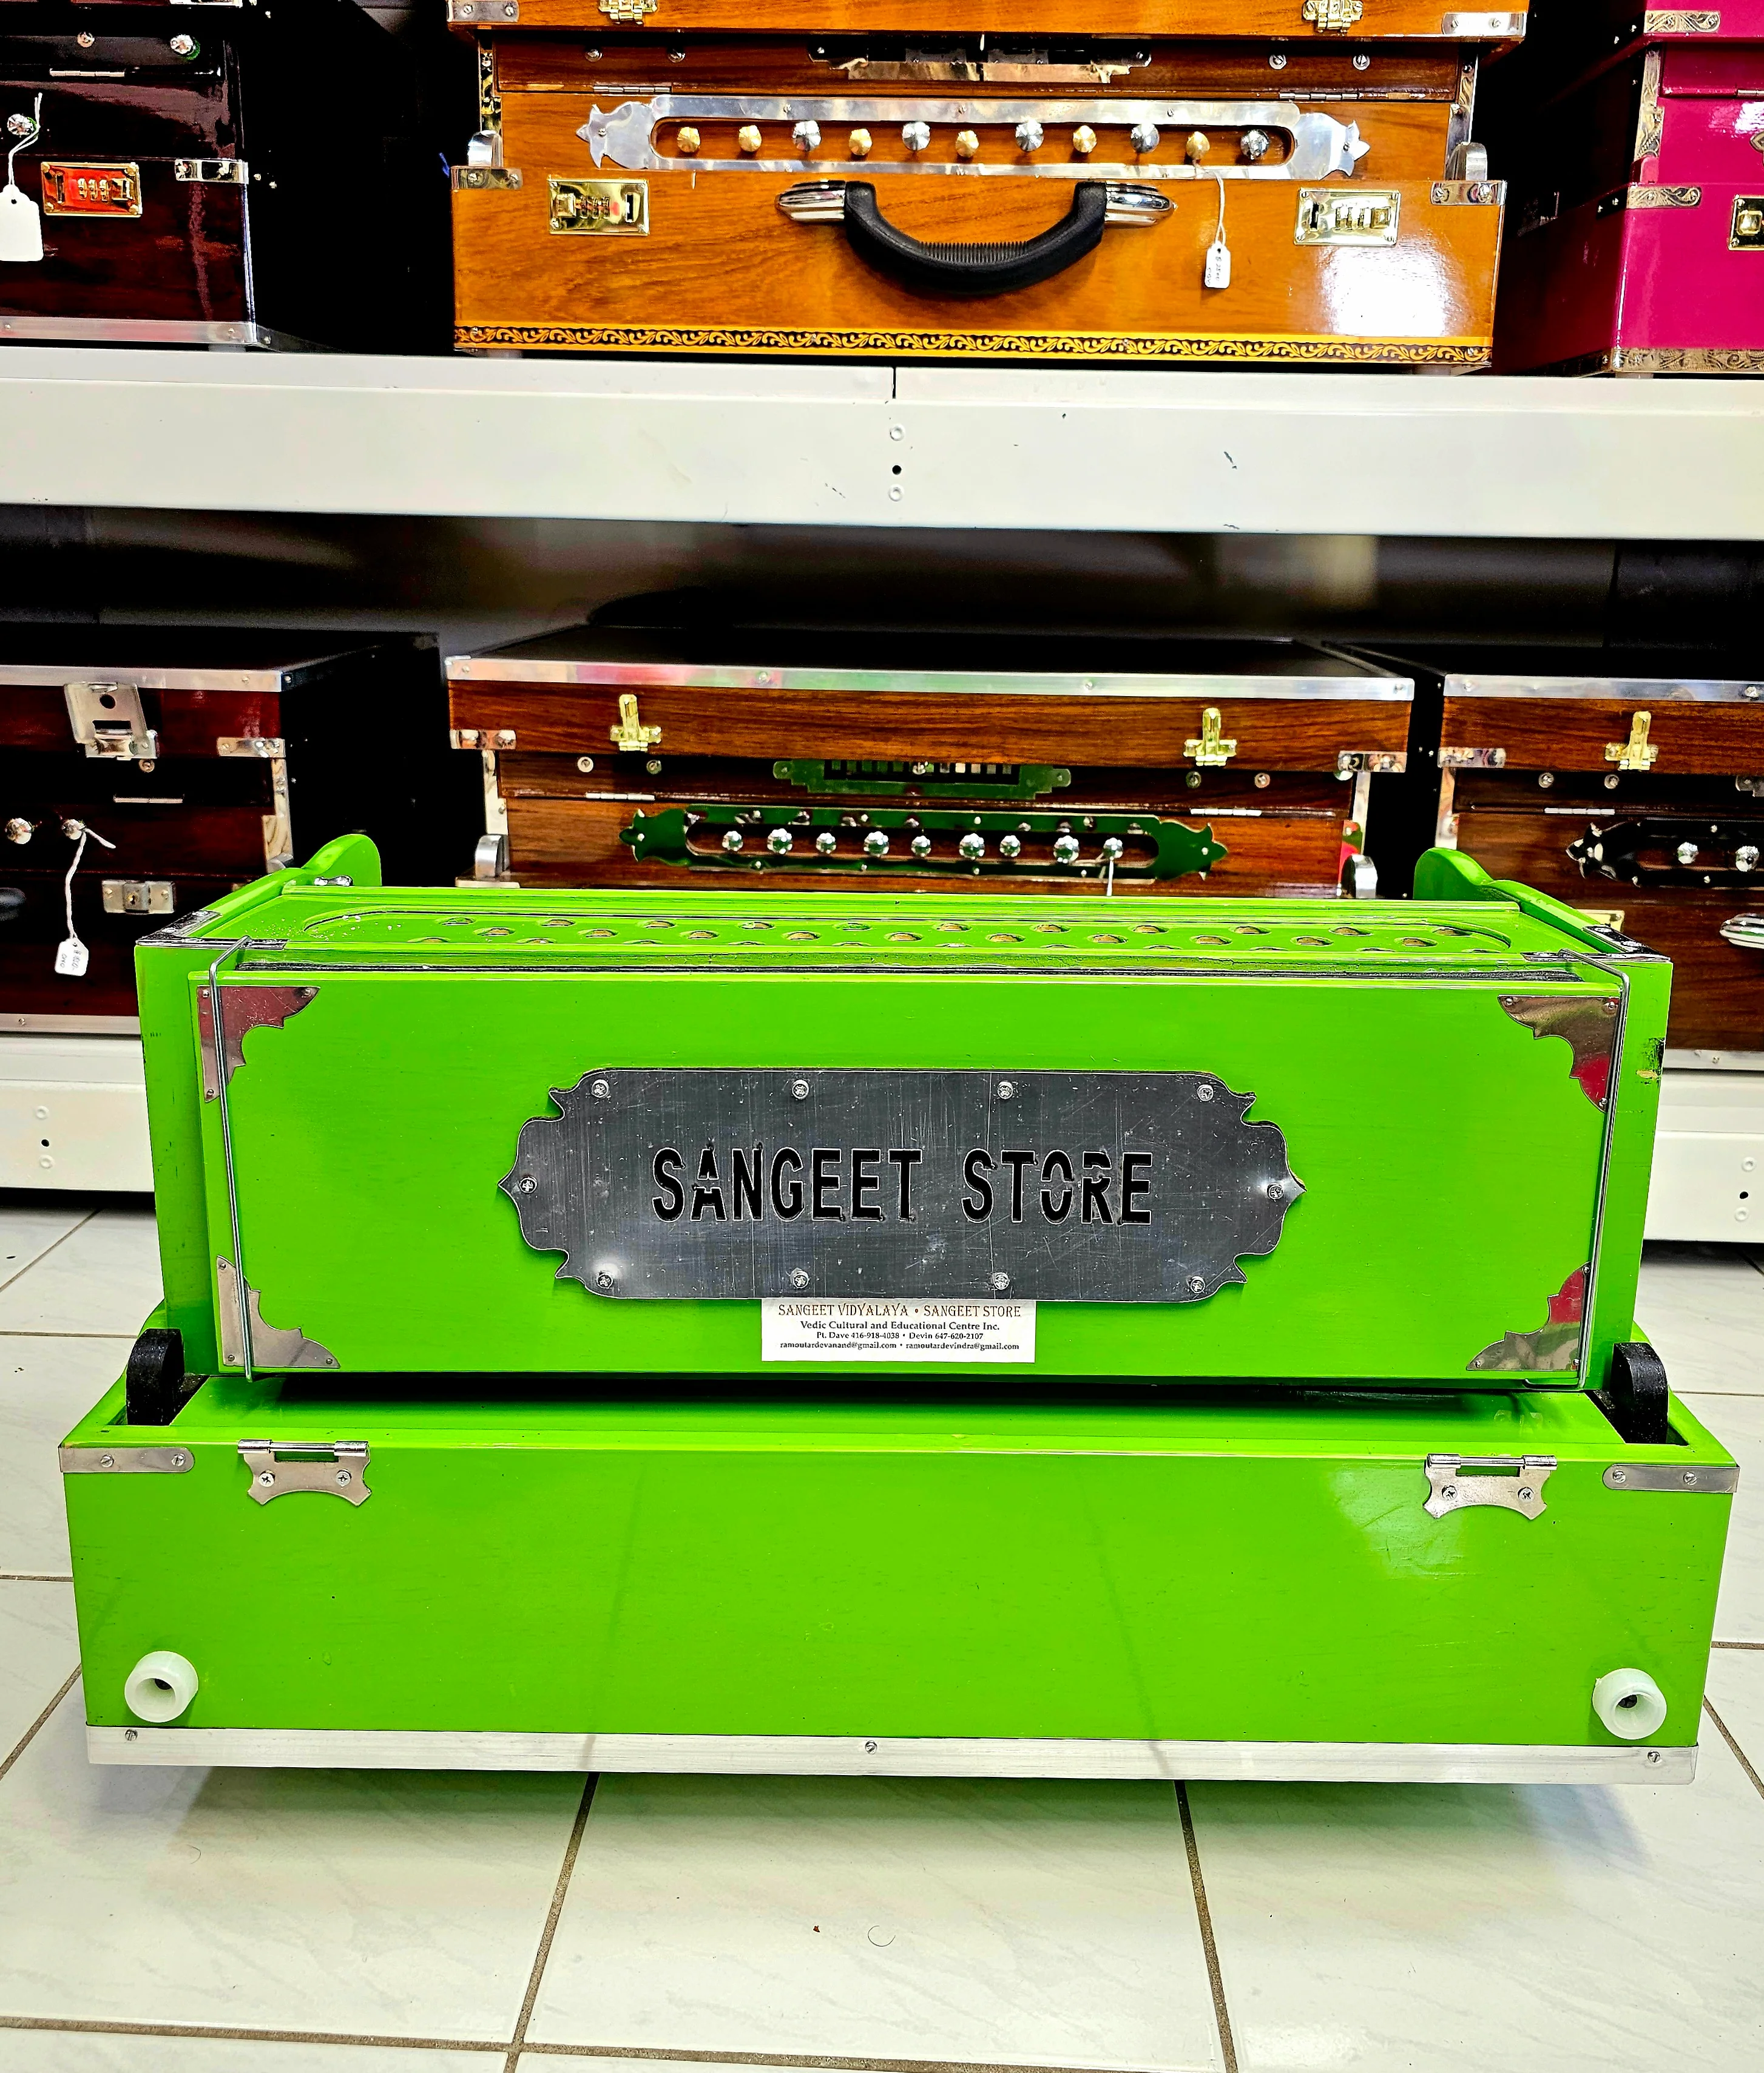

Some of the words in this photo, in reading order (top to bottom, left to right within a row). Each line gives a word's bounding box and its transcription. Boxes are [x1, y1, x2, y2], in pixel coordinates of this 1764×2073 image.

[652, 1146, 922, 1223] SANGEET
[961, 1148, 1153, 1225] STORE
[779, 1304, 835, 1316] SANGEET
[837, 1302, 908, 1316] VIDYALAYA
[924, 1305, 981, 1317] SANGEET
[983, 1305, 1021, 1317] STORE
[800, 1321, 826, 1329] Vedic
[828, 1321, 868, 1329] Cultural
[870, 1321, 888, 1329] and
[891, 1321, 946, 1330] Educational
[948, 1321, 980, 1330] Centre
[983, 1322, 1000, 1330] Inc.
[780, 1341, 897, 1350] ramoutardevanand@gmail.com
[905, 1342, 1019, 1351] ramoutardevindra@gmail.com
